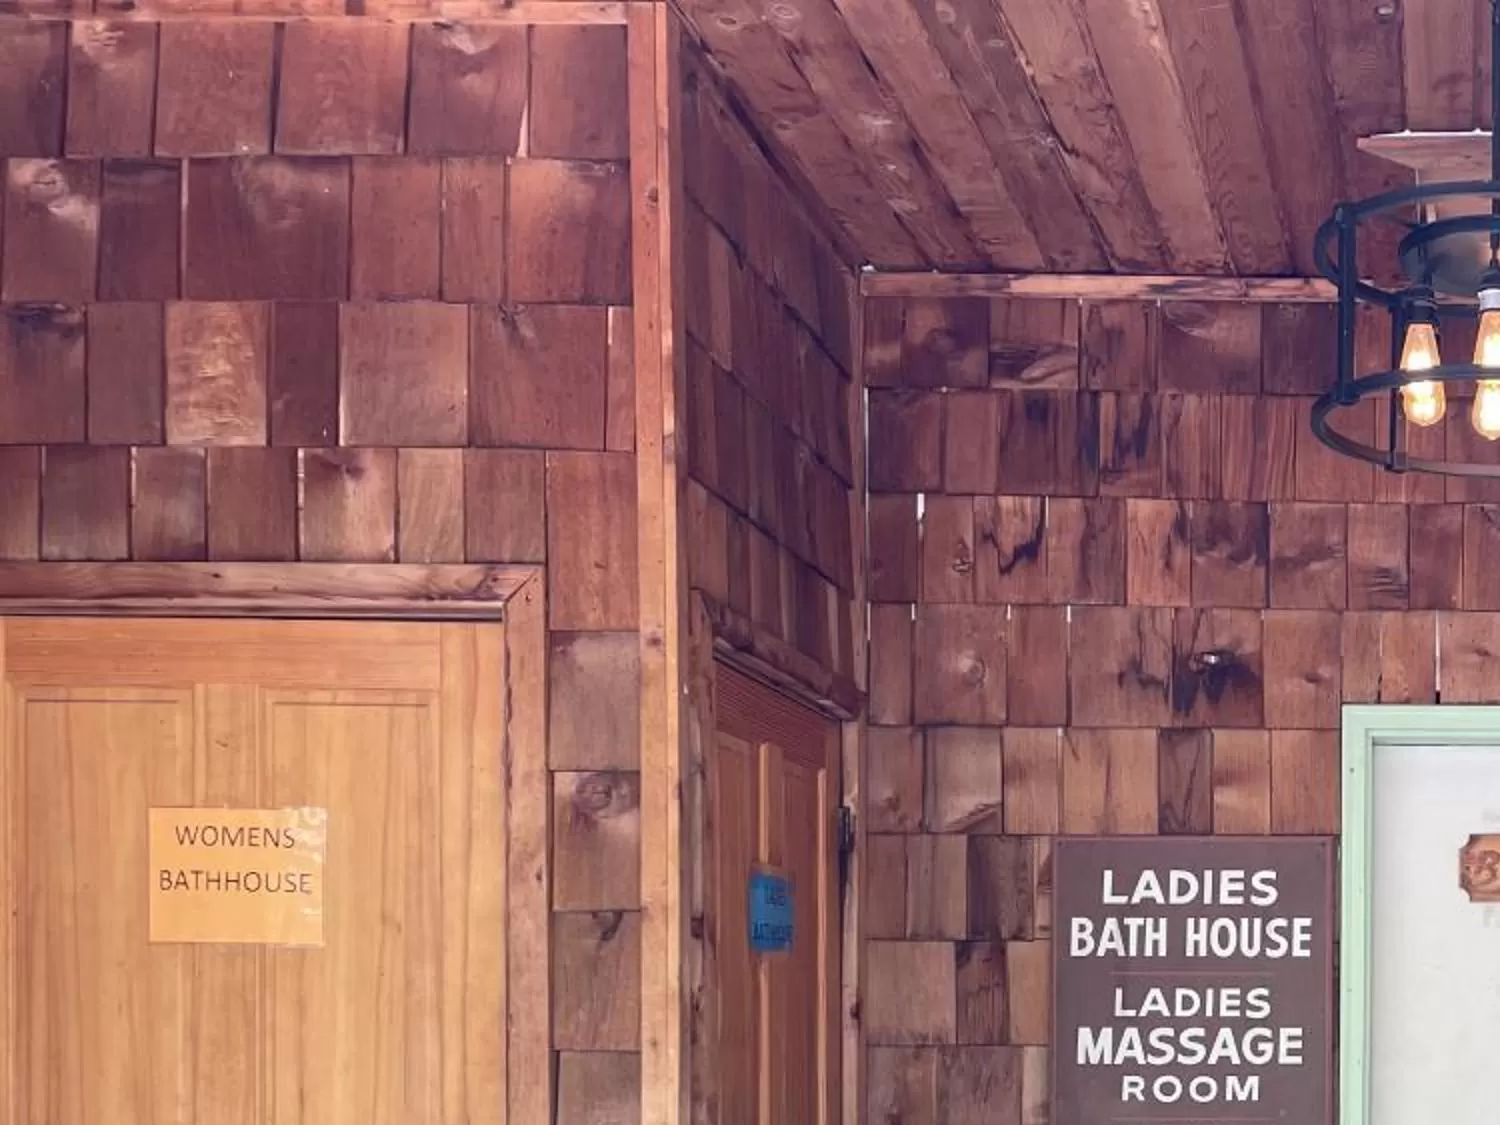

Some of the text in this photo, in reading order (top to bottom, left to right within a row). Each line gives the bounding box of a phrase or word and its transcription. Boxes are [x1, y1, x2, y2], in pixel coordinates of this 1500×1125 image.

[175, 825, 295, 848] WOMENS
[159, 869, 312, 893] BATHHOUSE
[1102, 869, 1279, 906] LADIES
[1070, 917, 1312, 957] BATH HOUSE
[1114, 987, 1272, 1019] LADIES
[1076, 1026, 1303, 1065] MASSAGE
[1121, 1075, 1260, 1103] ROOM
